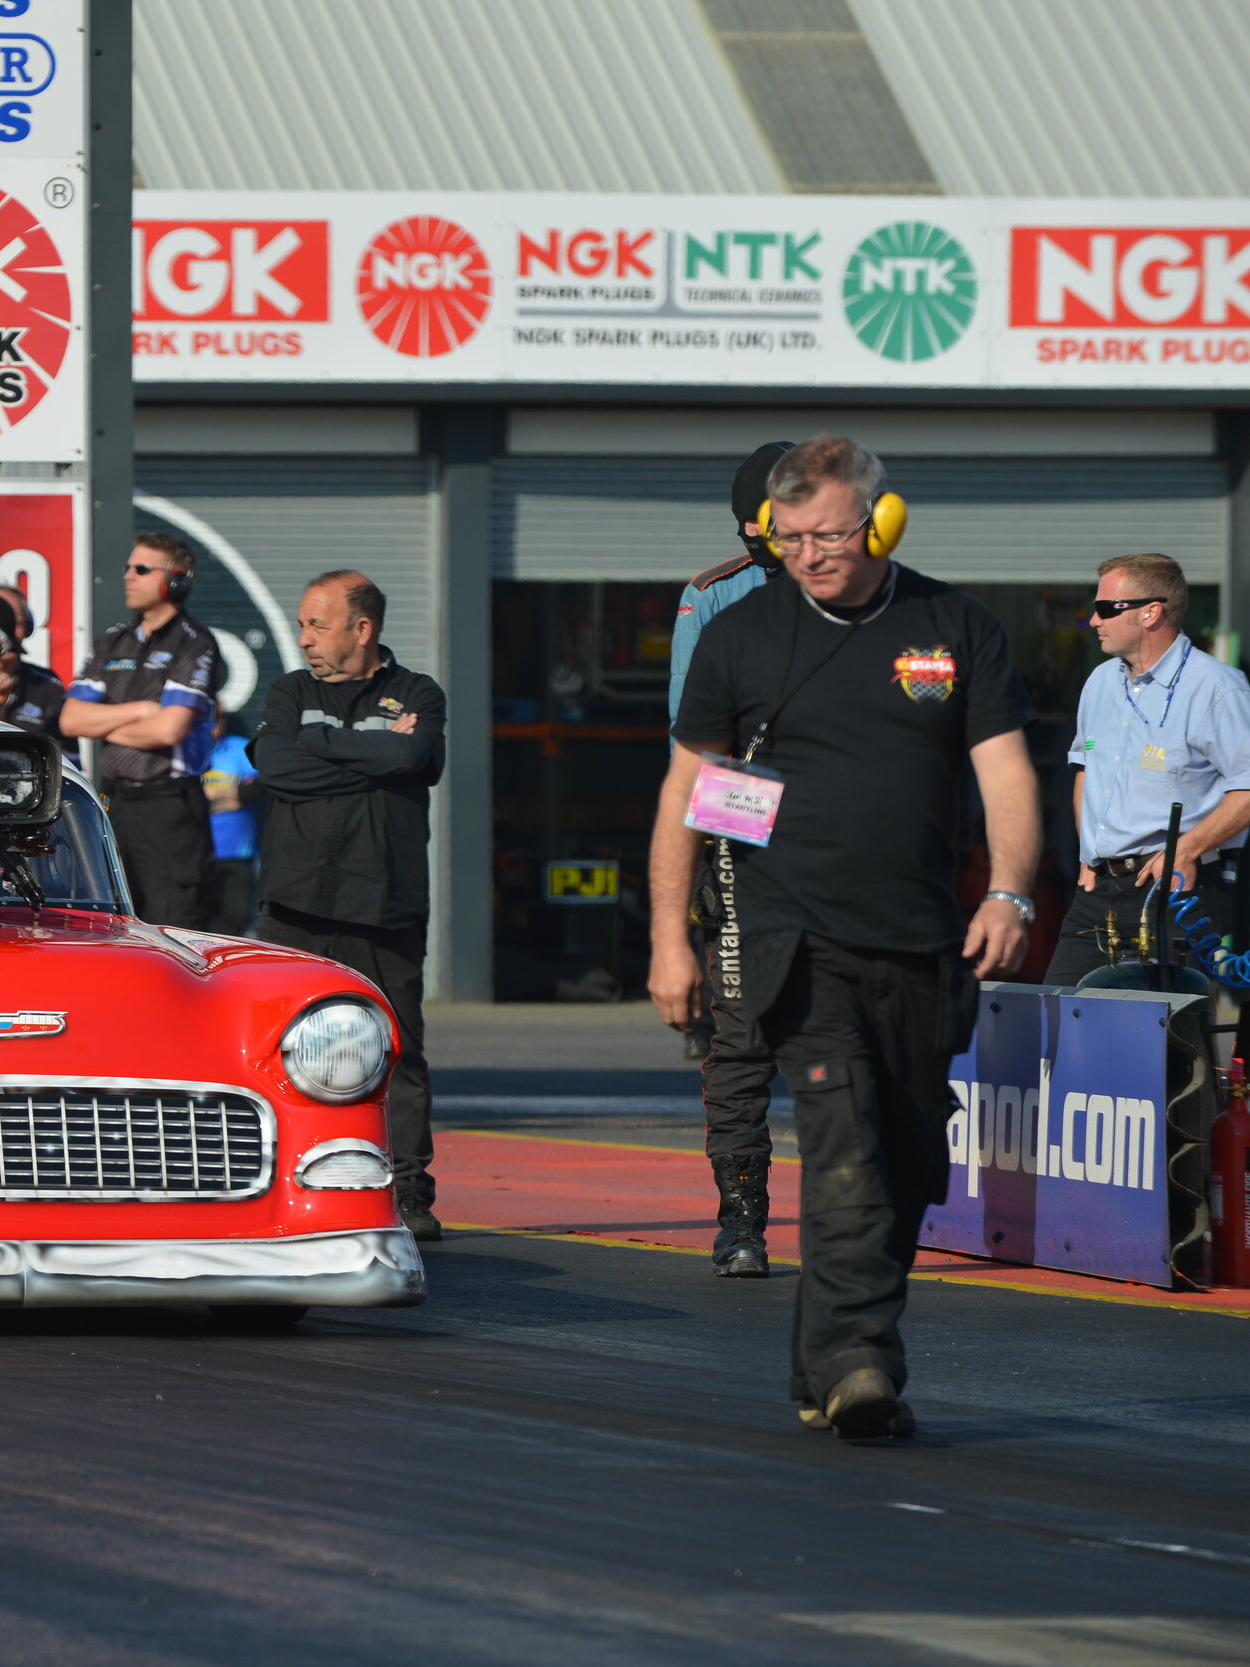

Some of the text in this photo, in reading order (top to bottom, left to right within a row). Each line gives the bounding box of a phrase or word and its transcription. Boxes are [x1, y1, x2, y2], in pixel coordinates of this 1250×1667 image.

[371, 252, 475, 291] NGK
[518, 228, 655, 278] NGK
[685, 231, 823, 281] NTK
[860, 257, 957, 295] NTK
[1037, 234, 1250, 323] NGK
[192, 331, 303, 356] PLUGS
[516, 327, 565, 345] NGK
[573, 329, 642, 346] SPARK
[651, 331, 720, 348] PLUGS
[728, 331, 774, 353] (UK)
[1037, 338, 1147, 362] SPARK
